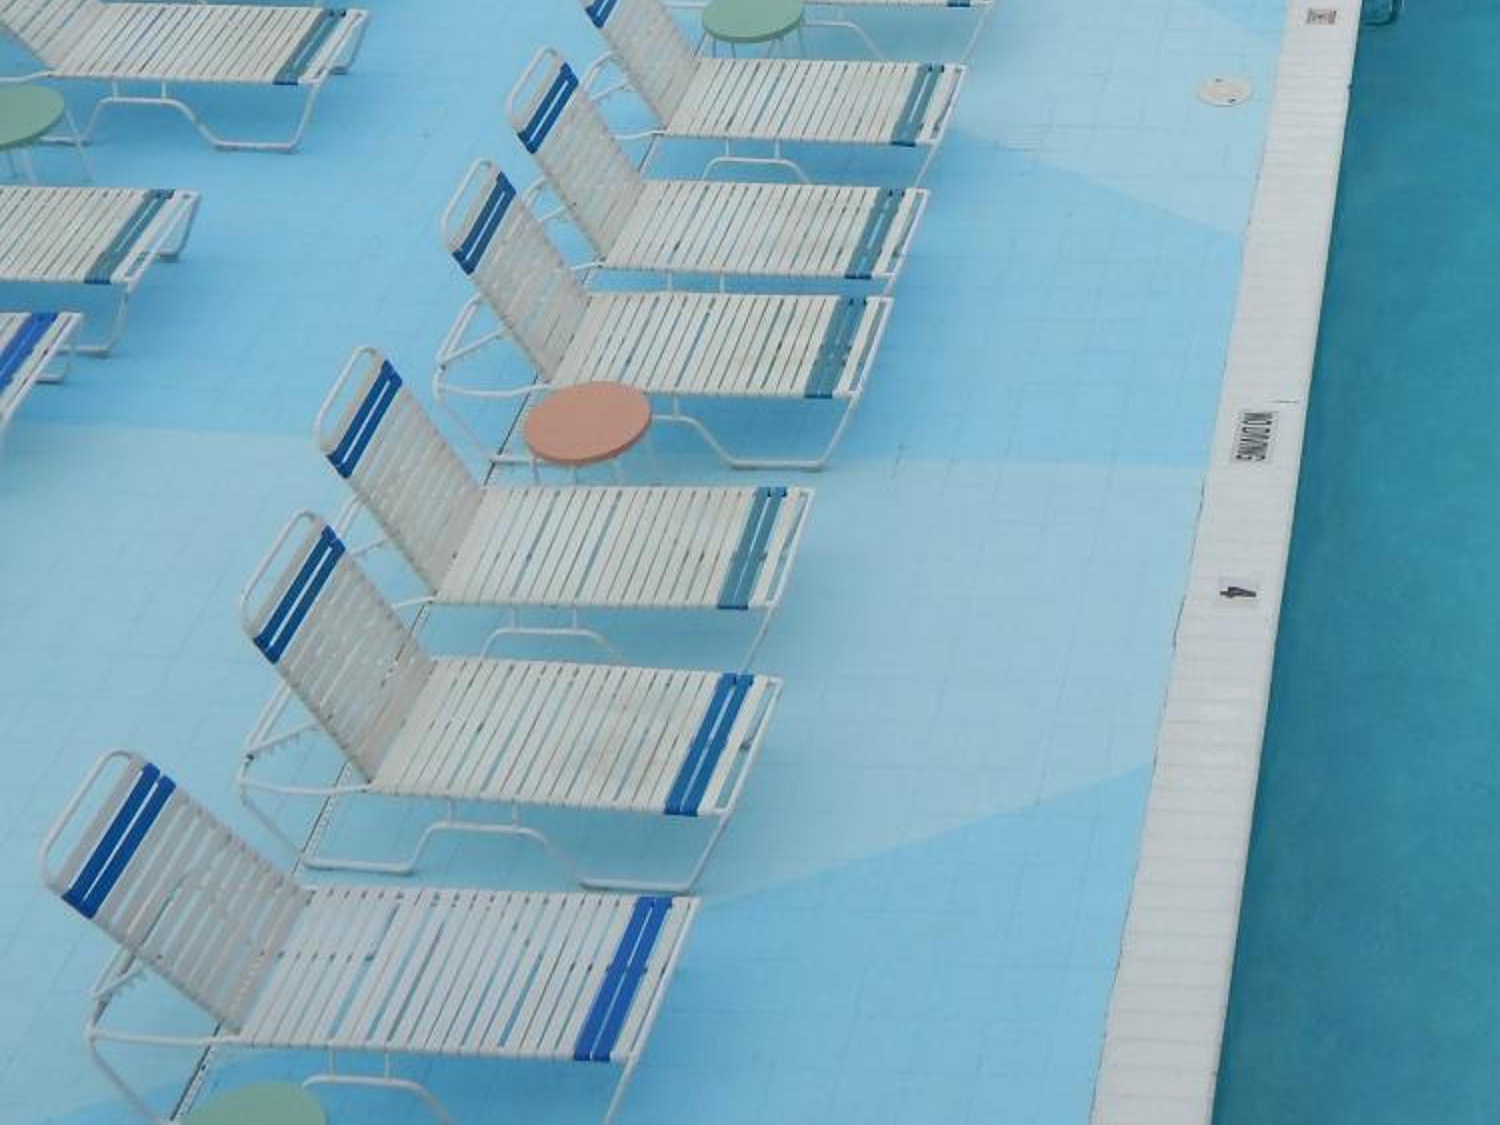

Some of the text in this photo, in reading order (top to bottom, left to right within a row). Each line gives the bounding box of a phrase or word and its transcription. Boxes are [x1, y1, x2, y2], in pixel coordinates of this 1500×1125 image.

[1236, 412, 1272, 461] NO DIVING
[1220, 586, 1256, 598] 4
